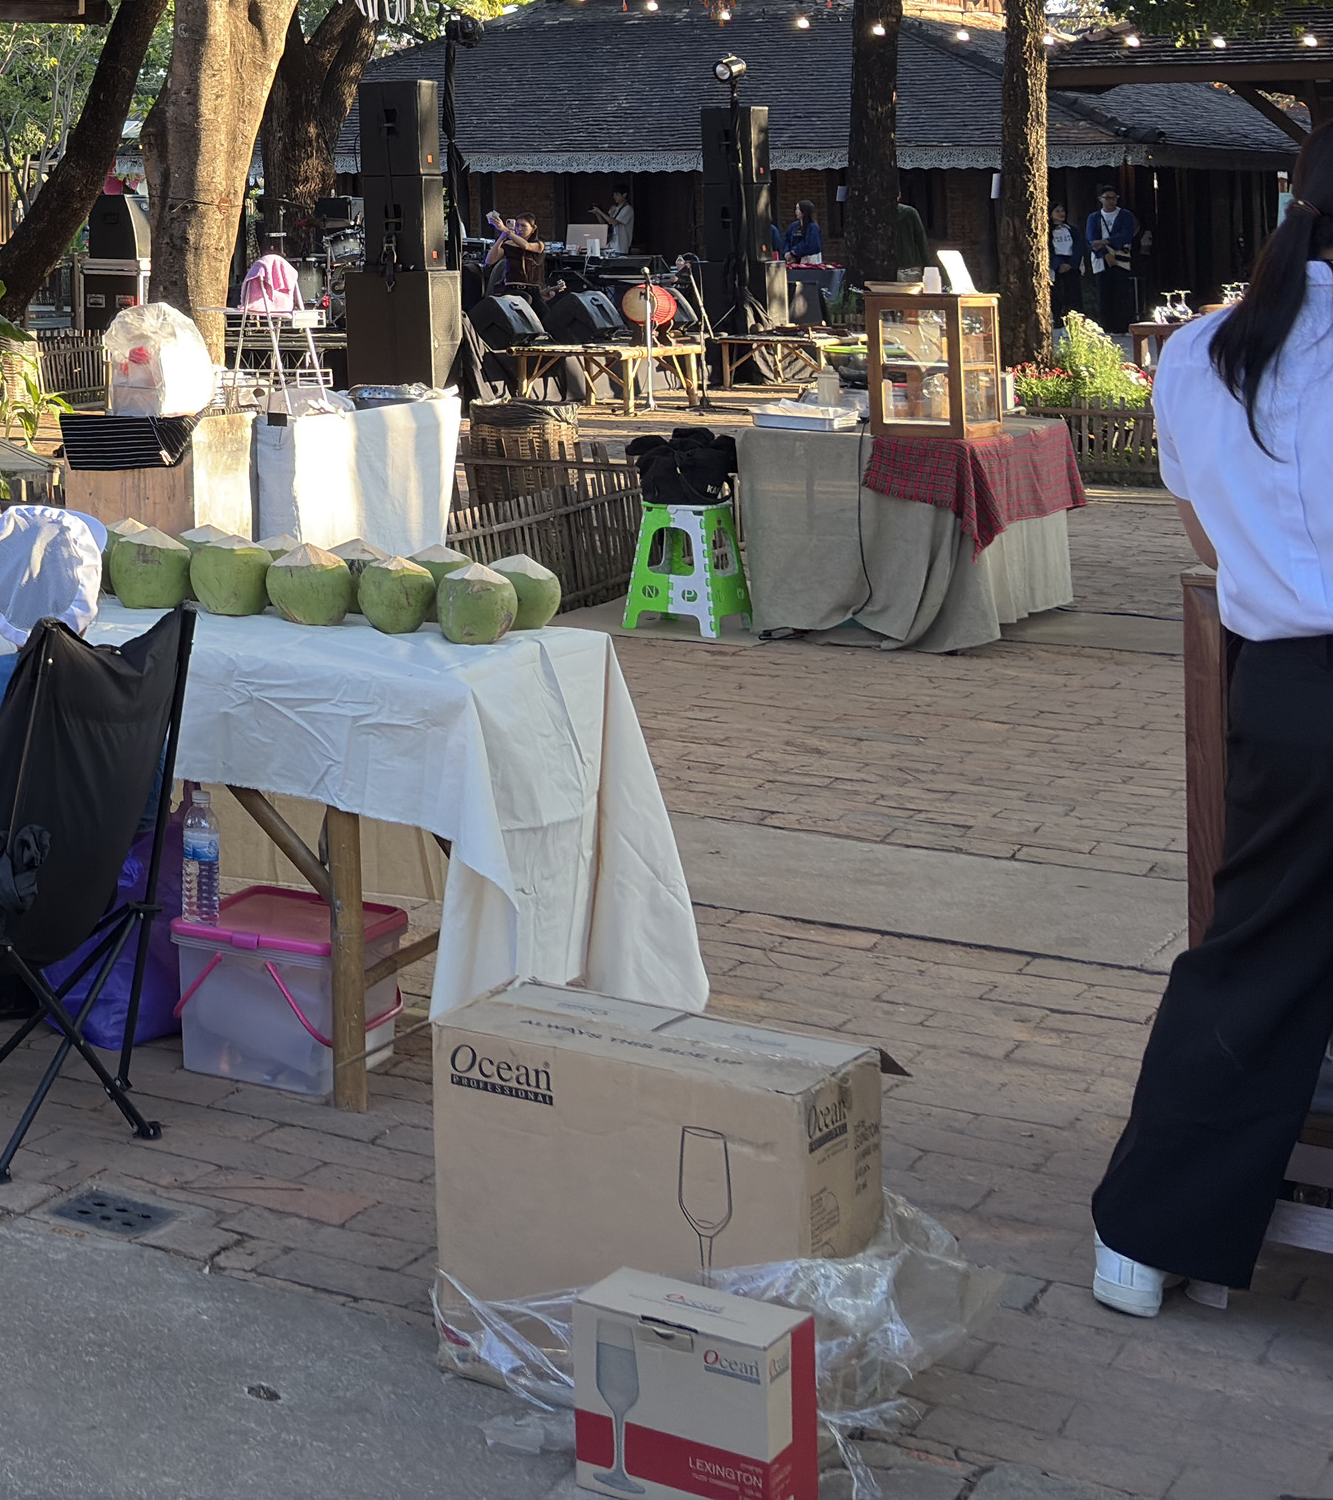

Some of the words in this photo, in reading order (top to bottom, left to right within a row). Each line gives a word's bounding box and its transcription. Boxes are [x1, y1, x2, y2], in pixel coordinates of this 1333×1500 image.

[519, 1018, 602, 1040] ALWAYS
[609, 1035, 654, 1049] THIS
[658, 1046, 710, 1057] SIDE
[450, 1044, 553, 1093] Ocean
[451, 1074, 553, 1105] PROFESSIONAL
[703, 1349, 760, 1378] Ocean
[688, 1456, 763, 1489] LEXINGTON
